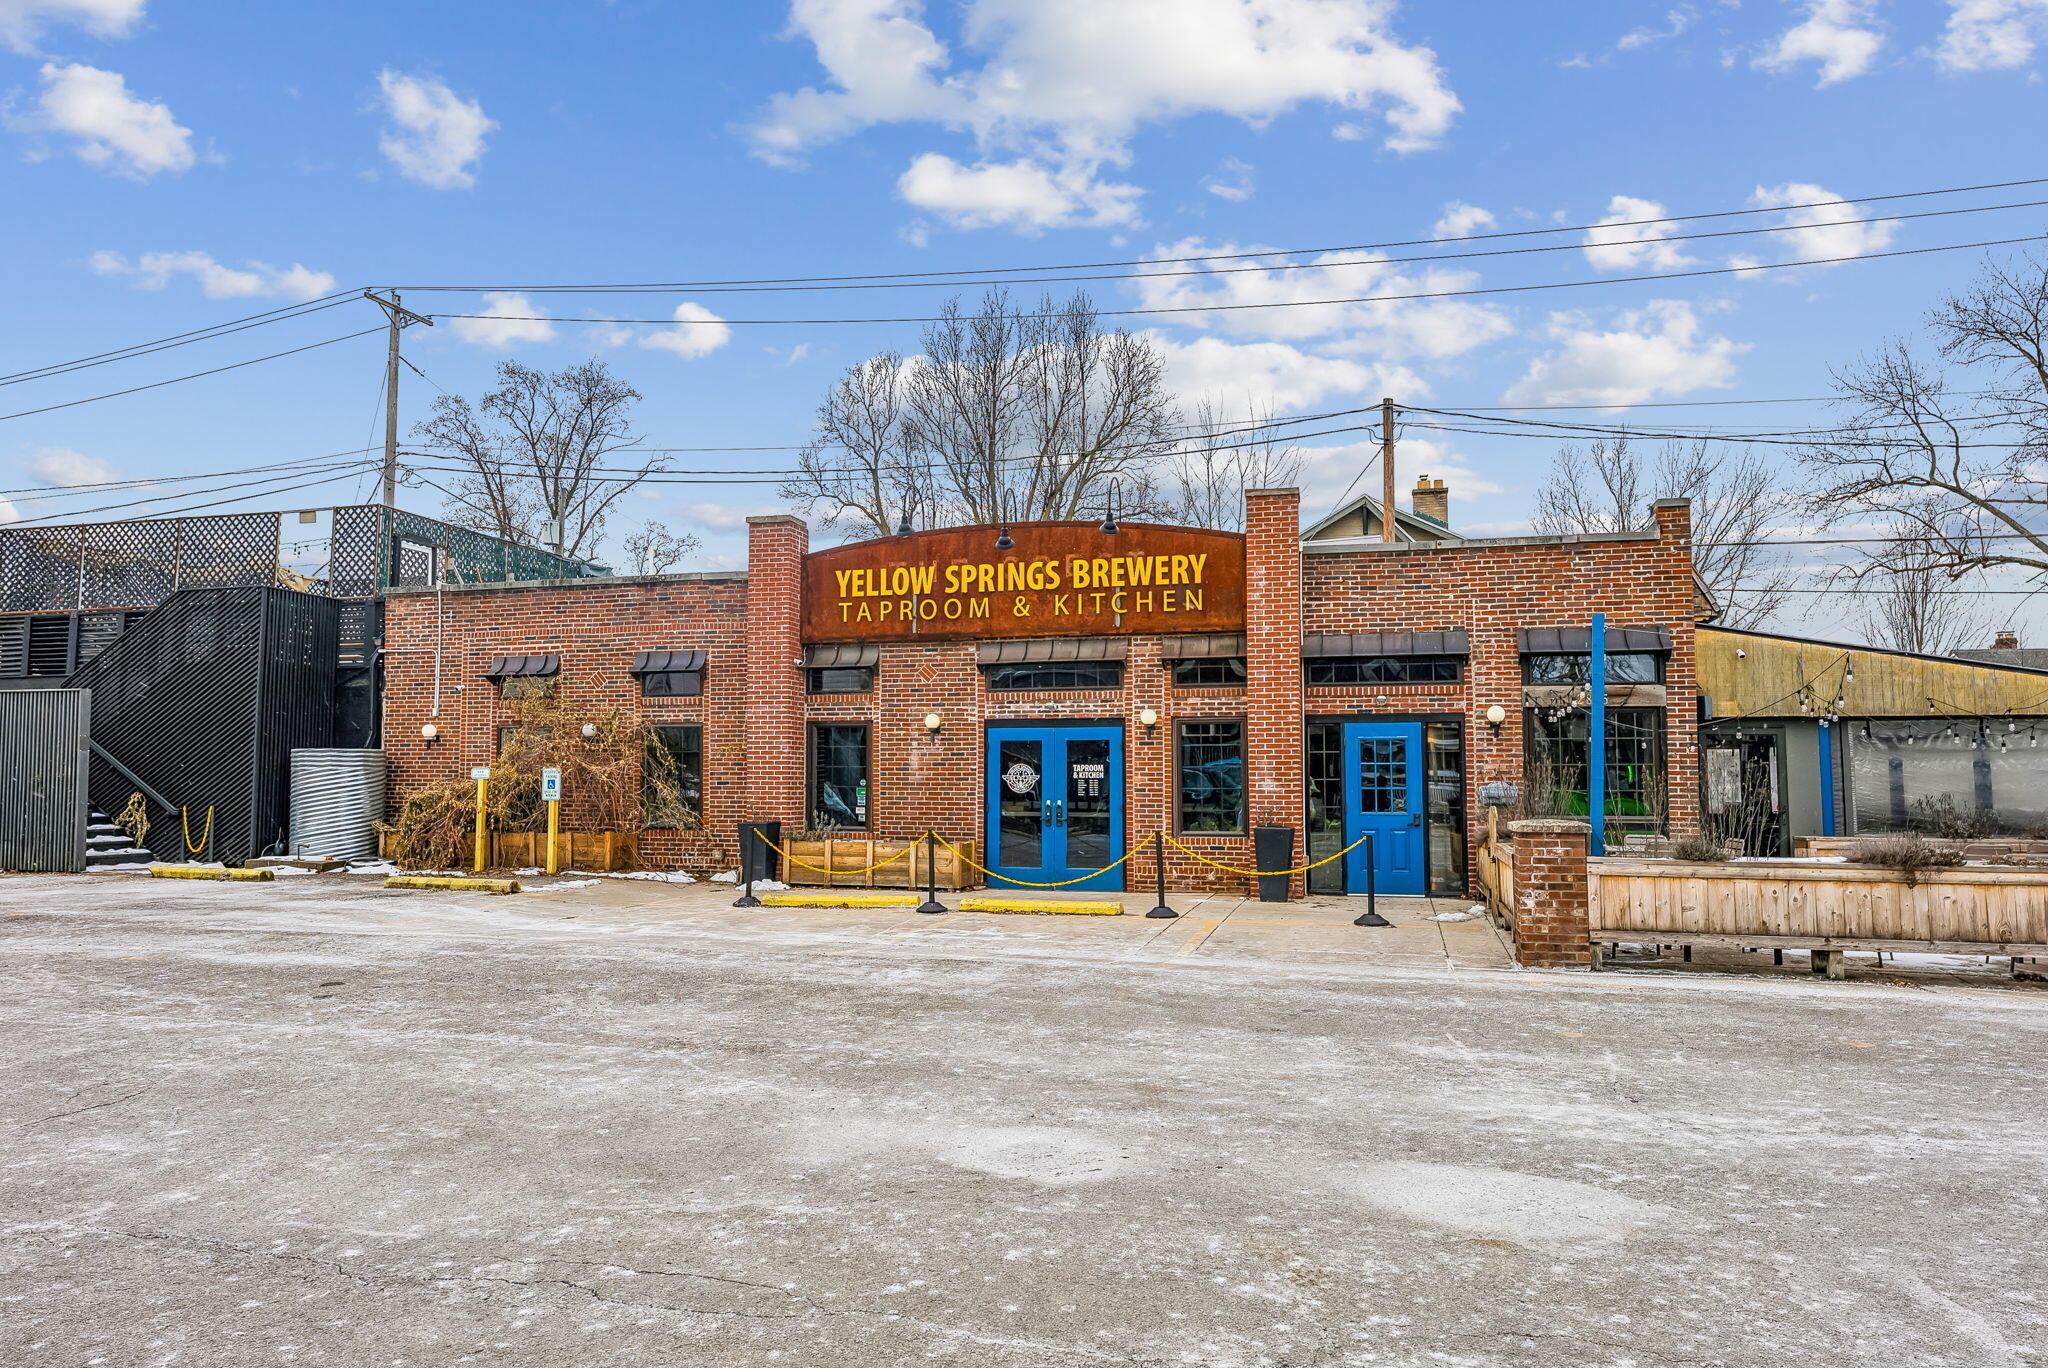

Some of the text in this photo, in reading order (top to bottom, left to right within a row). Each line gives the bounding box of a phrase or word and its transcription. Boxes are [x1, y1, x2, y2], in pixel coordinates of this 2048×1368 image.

[835, 553, 1208, 598] YELLOW SPRINGS BREWERY
[838, 589, 1203, 623] TAPROOM & KITCHEN
[1072, 764, 1104, 772] TAPROOM
[1072, 771, 1105, 779] & KITCHEN
